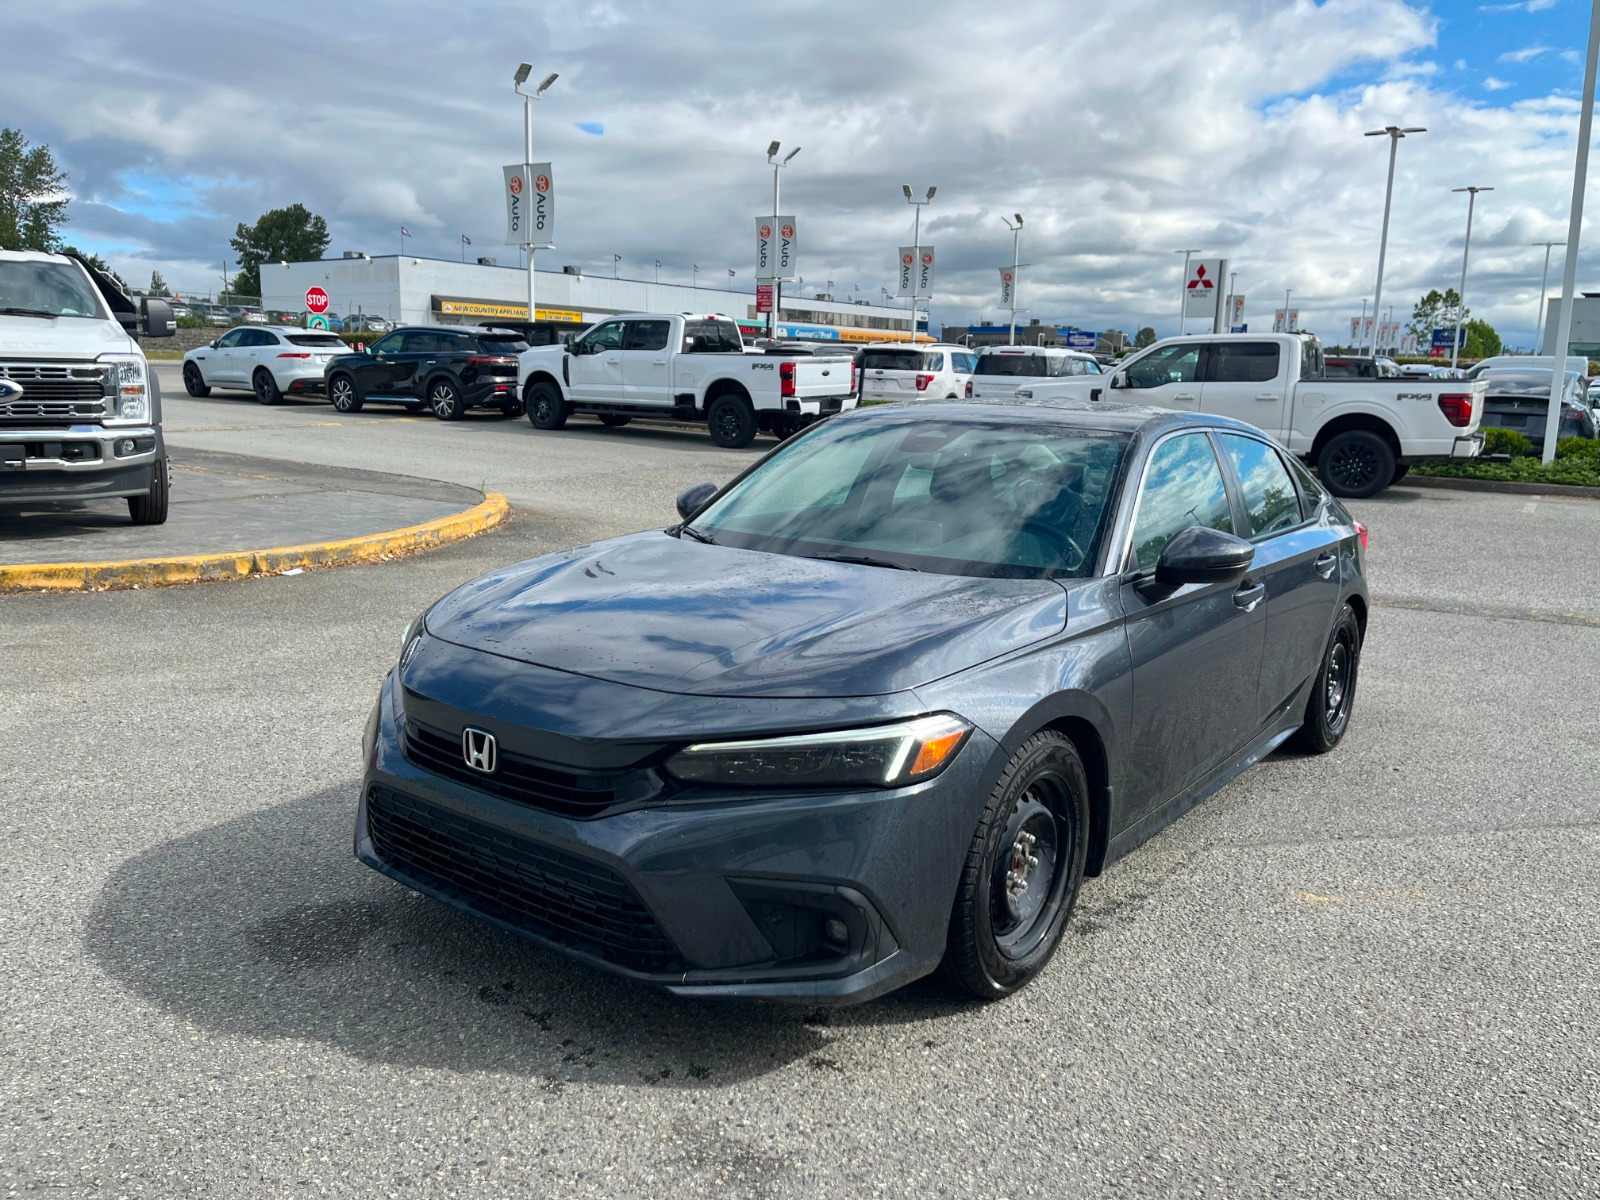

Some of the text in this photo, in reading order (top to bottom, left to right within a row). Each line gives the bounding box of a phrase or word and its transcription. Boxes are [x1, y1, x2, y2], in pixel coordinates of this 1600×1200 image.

[511, 195, 520, 231] Auto
[536, 193, 547, 230] Auto
[760, 239, 768, 268] Auto
[781, 238, 790, 268] Auto
[902, 265, 910, 288] Auto
[921, 264, 929, 289] Auto
[307, 294, 327, 305] STOP
[453, 304, 529, 316] NEW COUNTRY APPLIANC
